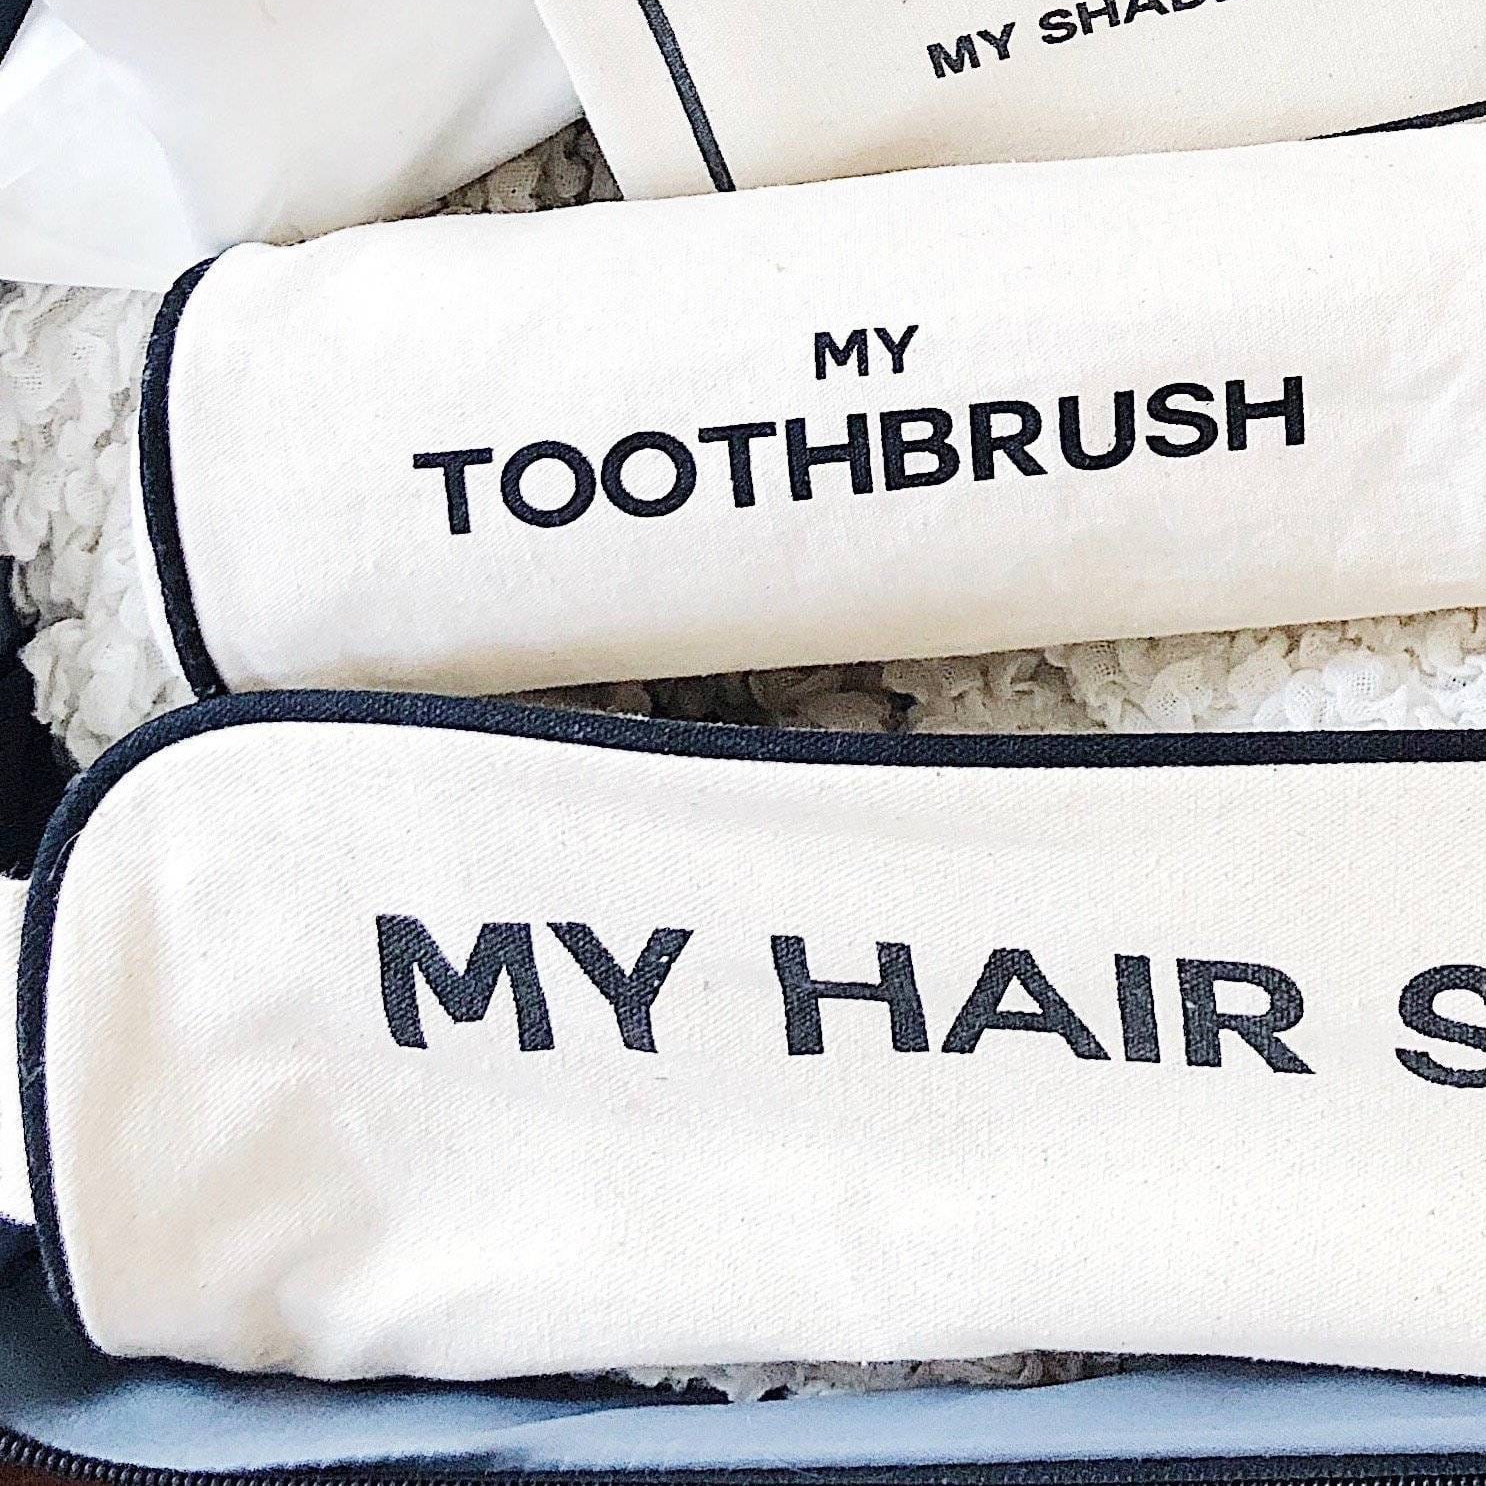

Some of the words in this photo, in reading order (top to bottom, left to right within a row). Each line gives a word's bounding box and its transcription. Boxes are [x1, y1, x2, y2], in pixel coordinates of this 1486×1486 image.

[927, 22, 1015, 78] MY
[814, 325, 919, 381] MY
[413, 376, 1305, 535] TOOTHBRUSH
[376, 914, 695, 1054] MY
[770, 934, 1316, 1075] HAIR
